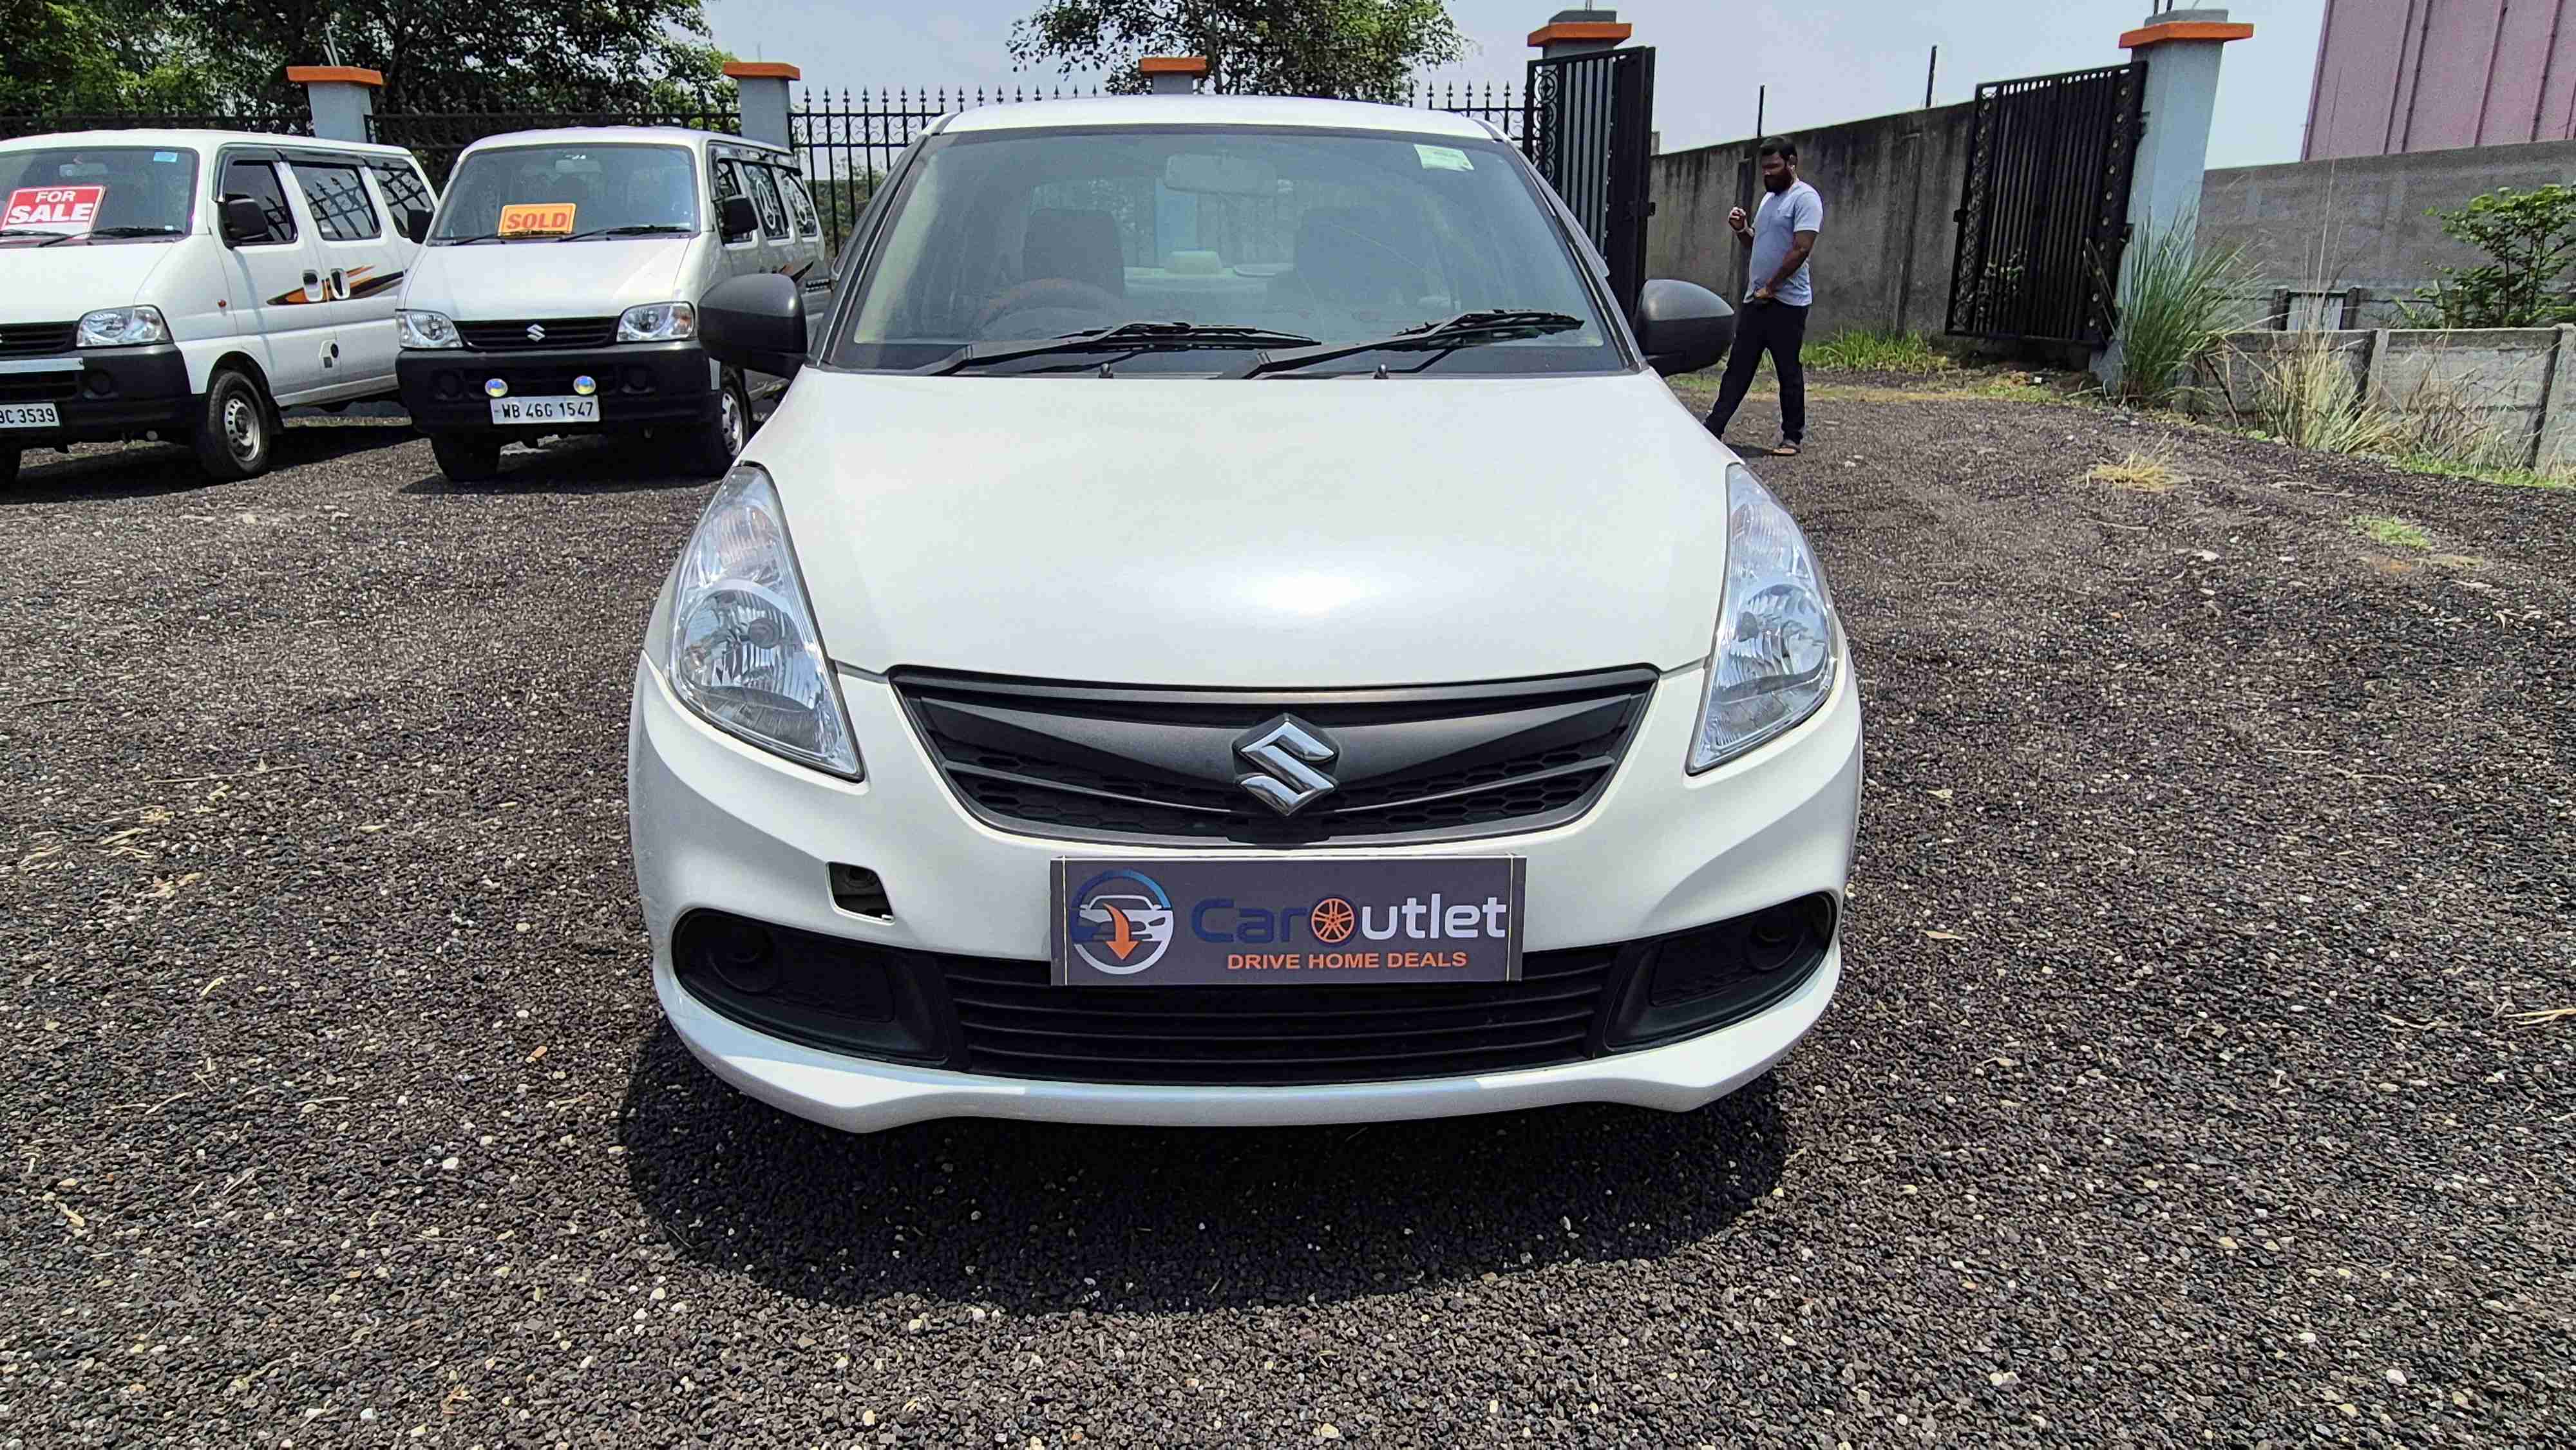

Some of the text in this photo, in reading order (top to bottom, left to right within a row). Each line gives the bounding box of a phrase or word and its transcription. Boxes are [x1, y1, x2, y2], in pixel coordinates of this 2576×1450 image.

[35, 191, 76, 203] FOR
[8, 203, 94, 223] SALE
[506, 212, 567, 229] SOLD
[17, 408, 55, 423] 3539
[502, 402, 593, 418] WB 46G 1547
[1227, 952, 1468, 970] DRIVE HOME DEALS
